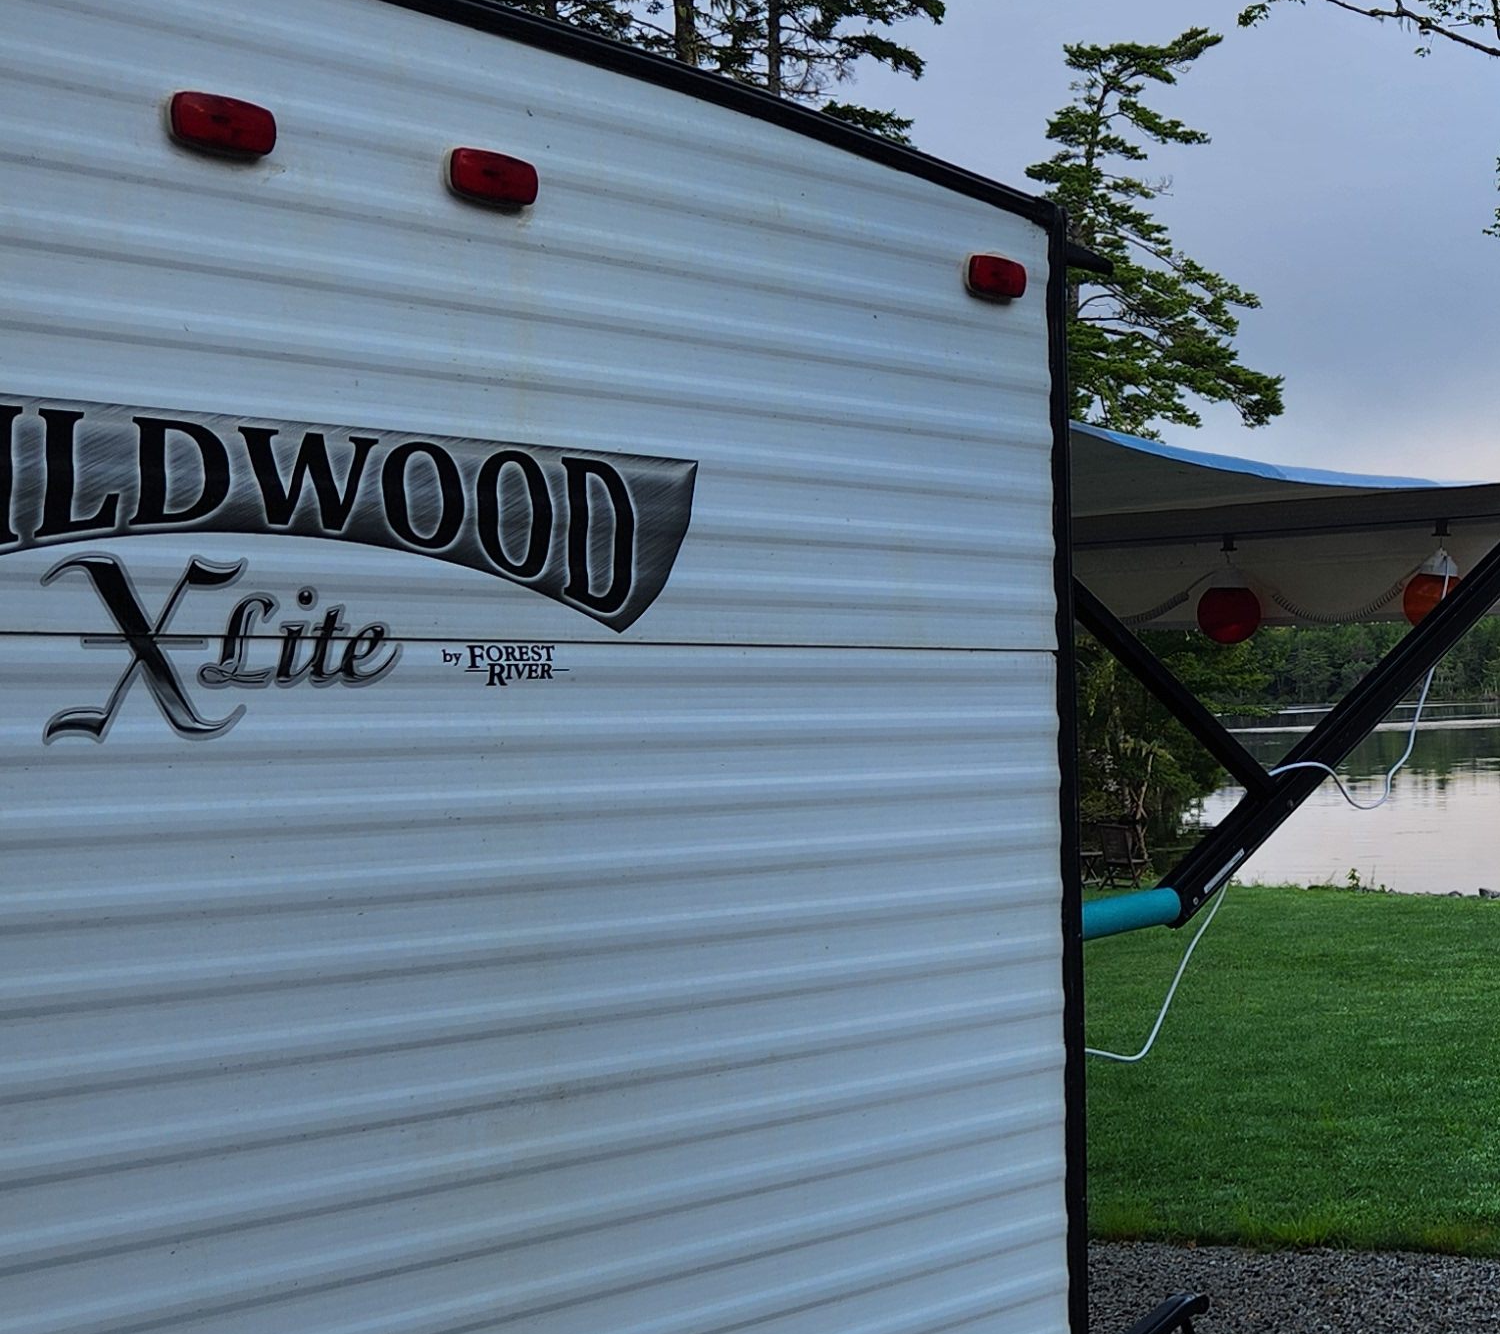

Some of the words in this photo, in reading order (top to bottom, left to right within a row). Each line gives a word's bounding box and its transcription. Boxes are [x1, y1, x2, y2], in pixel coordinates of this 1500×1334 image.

[442, 649, 462, 666] by
[466, 645, 555, 668] FOREST
[485, 663, 553, 686] RIVER
